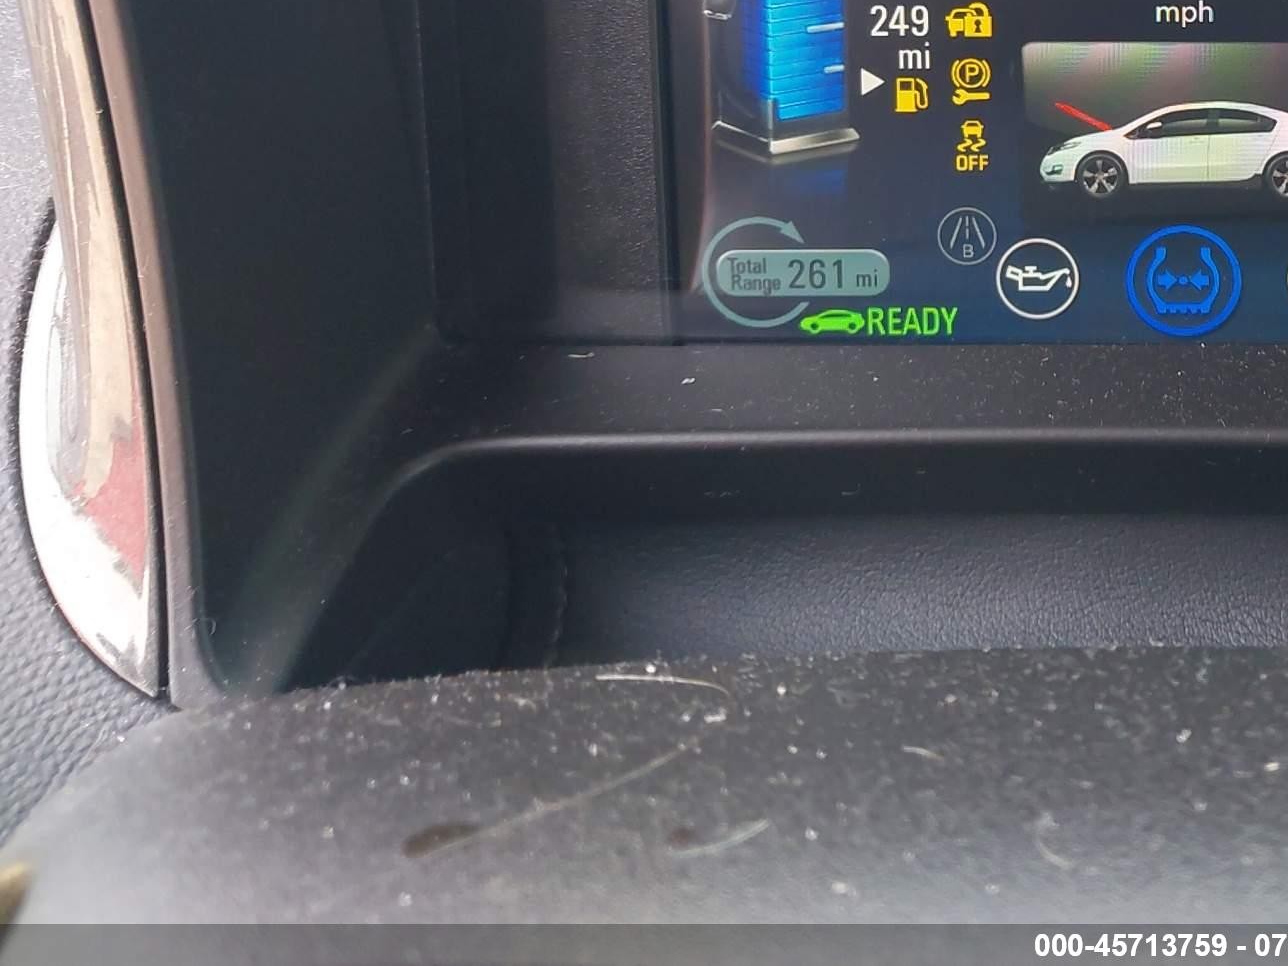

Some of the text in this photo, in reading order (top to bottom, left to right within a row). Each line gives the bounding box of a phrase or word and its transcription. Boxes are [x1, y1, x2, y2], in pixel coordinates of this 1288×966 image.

[870, 5, 929, 37] 249
[1155, 0, 1214, 28] mph
[898, 42, 931, 70] mi
[955, 154, 989, 172] OFF
[963, 244, 975, 259] B
[727, 257, 767, 275] Total
[788, 259, 879, 290] 261 mi
[731, 274, 781, 295] Range
[867, 307, 958, 336] READY
